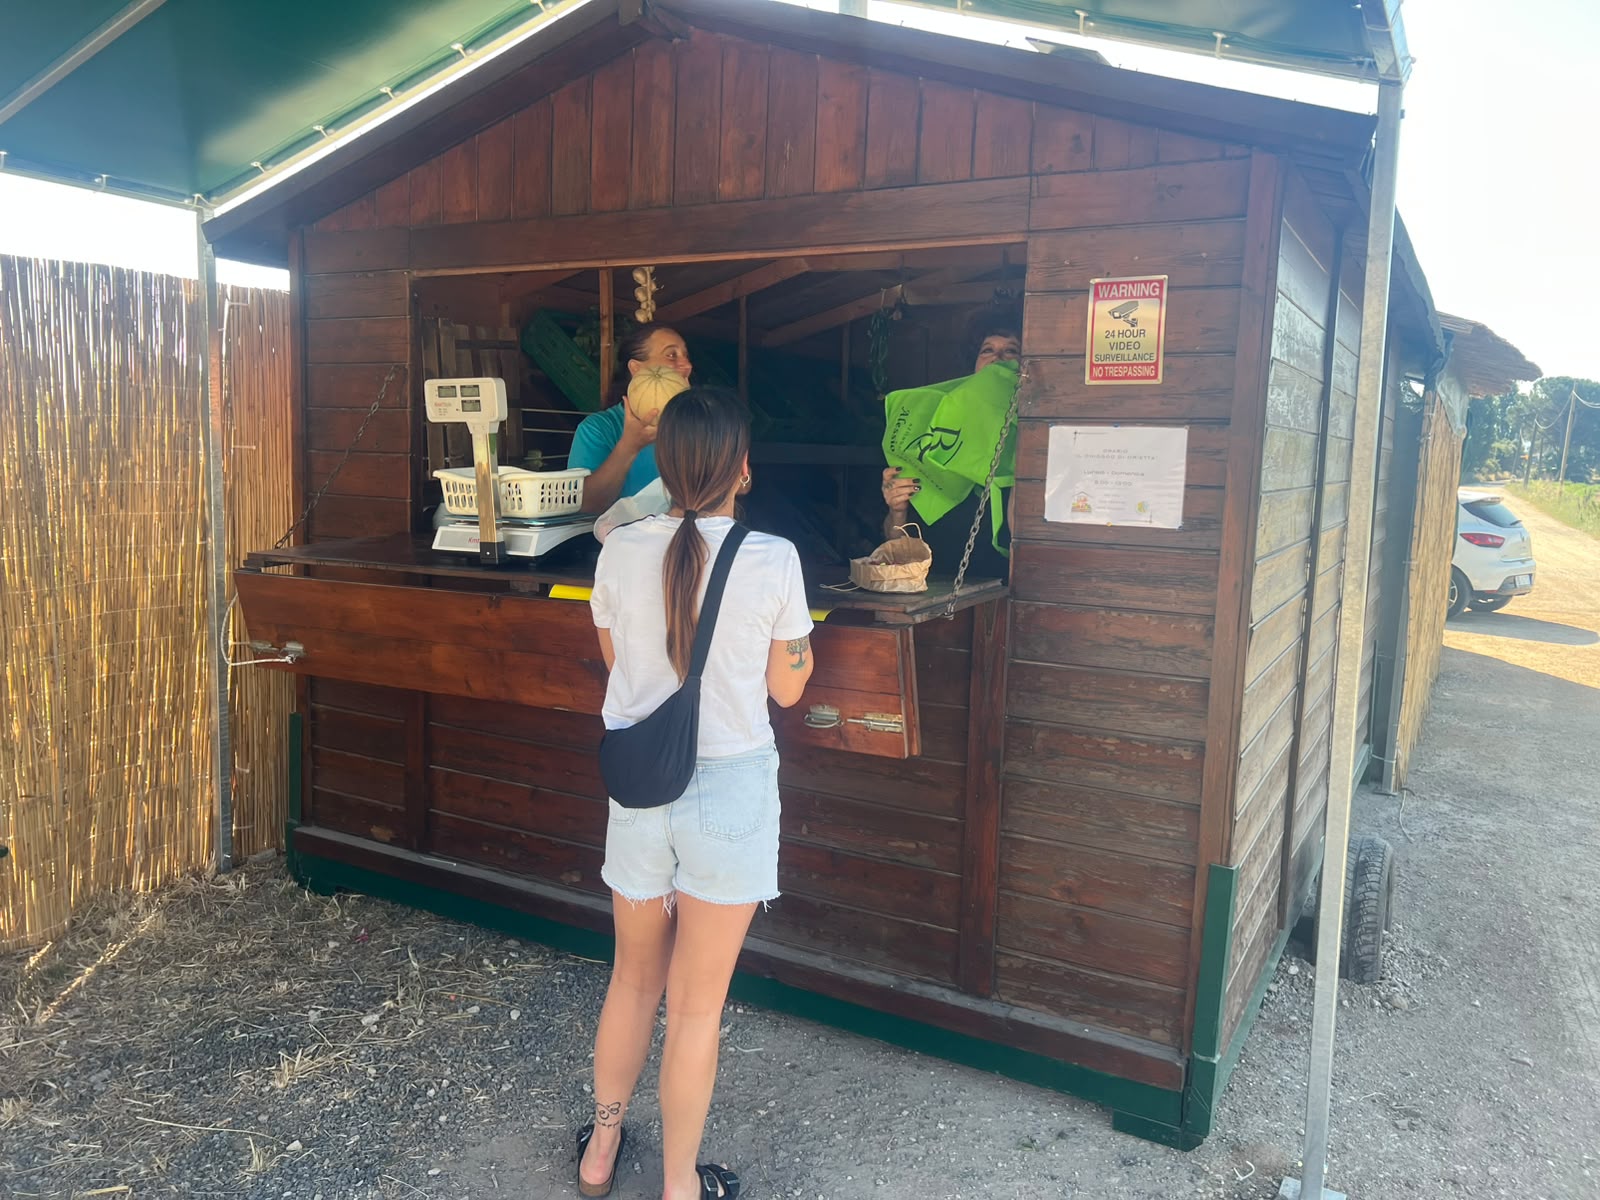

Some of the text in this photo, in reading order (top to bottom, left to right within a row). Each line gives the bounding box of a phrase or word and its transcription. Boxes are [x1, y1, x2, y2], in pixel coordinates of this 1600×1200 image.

[1098, 282, 1160, 298] WARNING
[1105, 329, 1146, 339] 24 HOUR
[1109, 341, 1141, 350] VIDEO
[1094, 353, 1155, 362] SURVEILLANCE
[1093, 366, 1155, 377] NO TRESPASSING
[890, 405, 910, 453] Alessio
